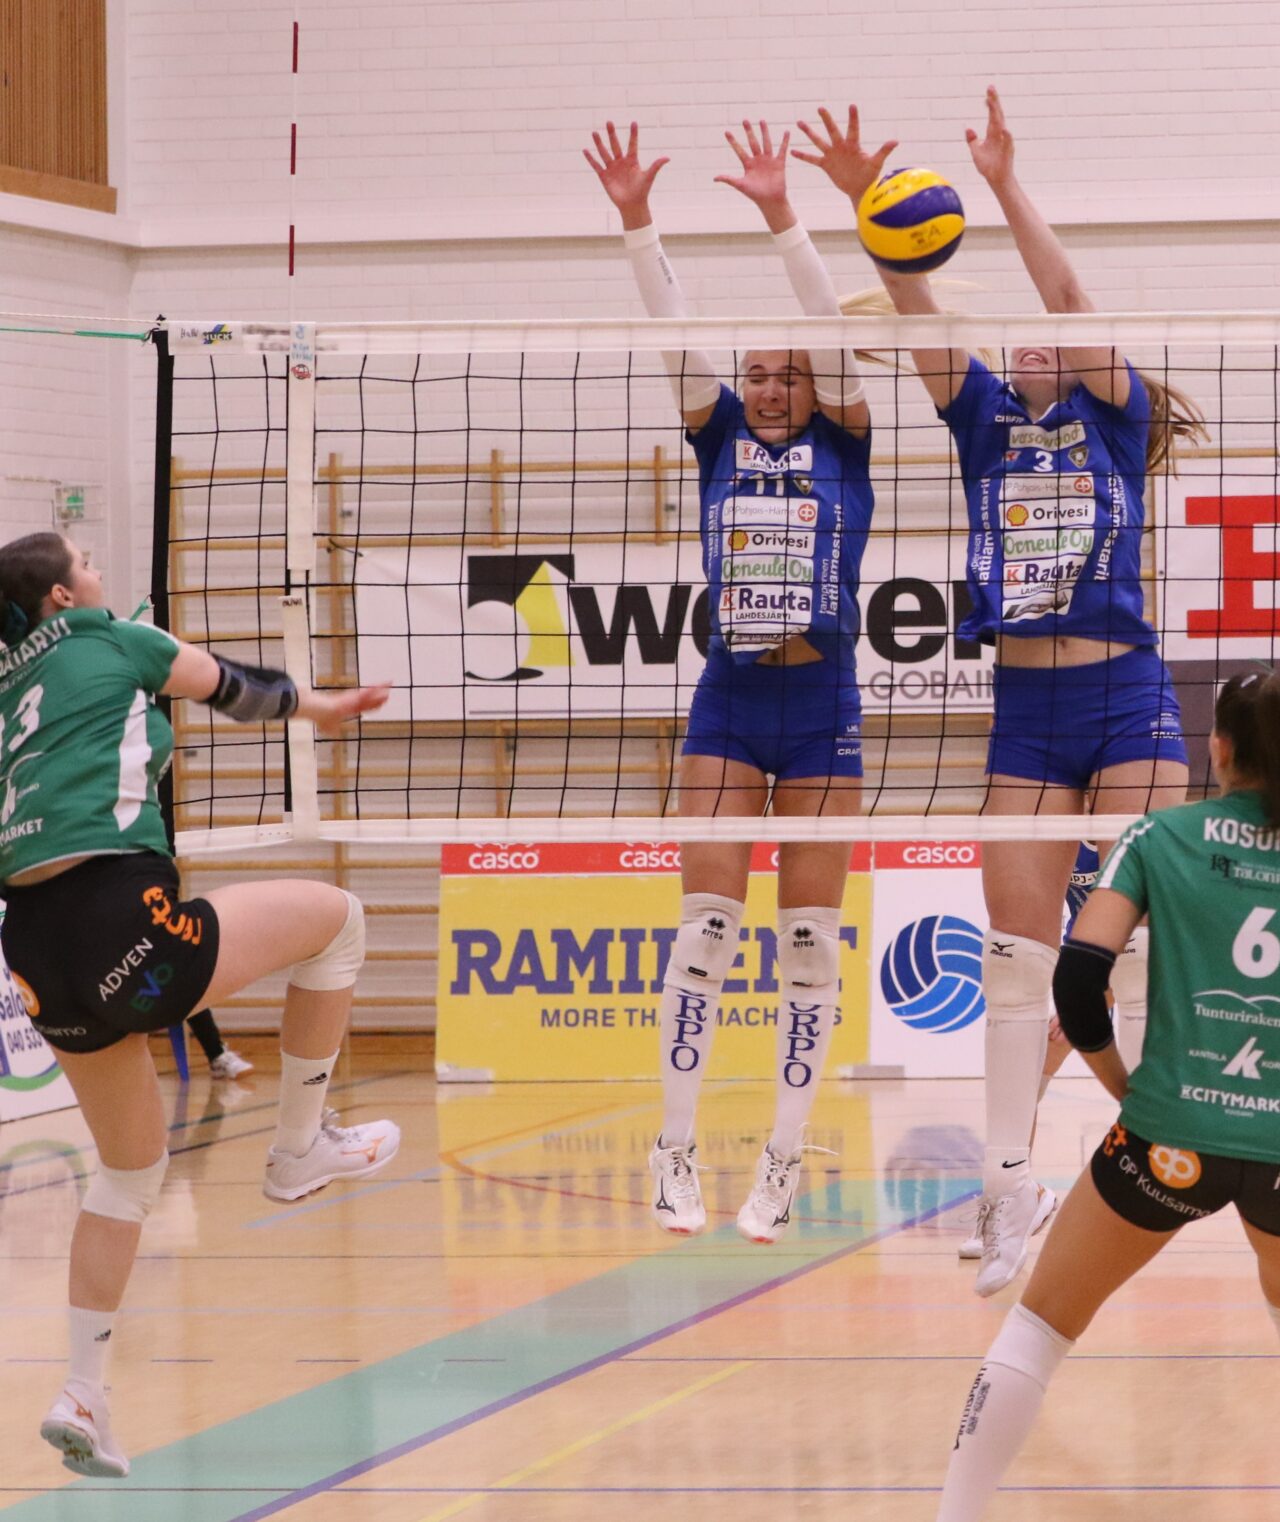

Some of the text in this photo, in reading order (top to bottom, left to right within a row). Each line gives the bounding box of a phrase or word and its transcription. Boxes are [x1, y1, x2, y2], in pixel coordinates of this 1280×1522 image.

[1033, 451, 1053, 472] 3
[748, 472, 784, 496] 11
[1032, 505, 1088, 520] Orivesi
[752, 533, 808, 549] Orivesi
[1070, 529, 1093, 553] Oy
[789, 559, 812, 581] Oy
[1025, 562, 1082, 584] Rauta
[739, 588, 811, 611] Rauta
[468, 852, 539, 869] casco
[903, 846, 974, 864] casco
[99, 937, 154, 1002] ADVEN
[540, 1007, 615, 1028] MORE
[671, 989, 707, 1071] RPO
[1119, 1154, 1138, 1175] OP
